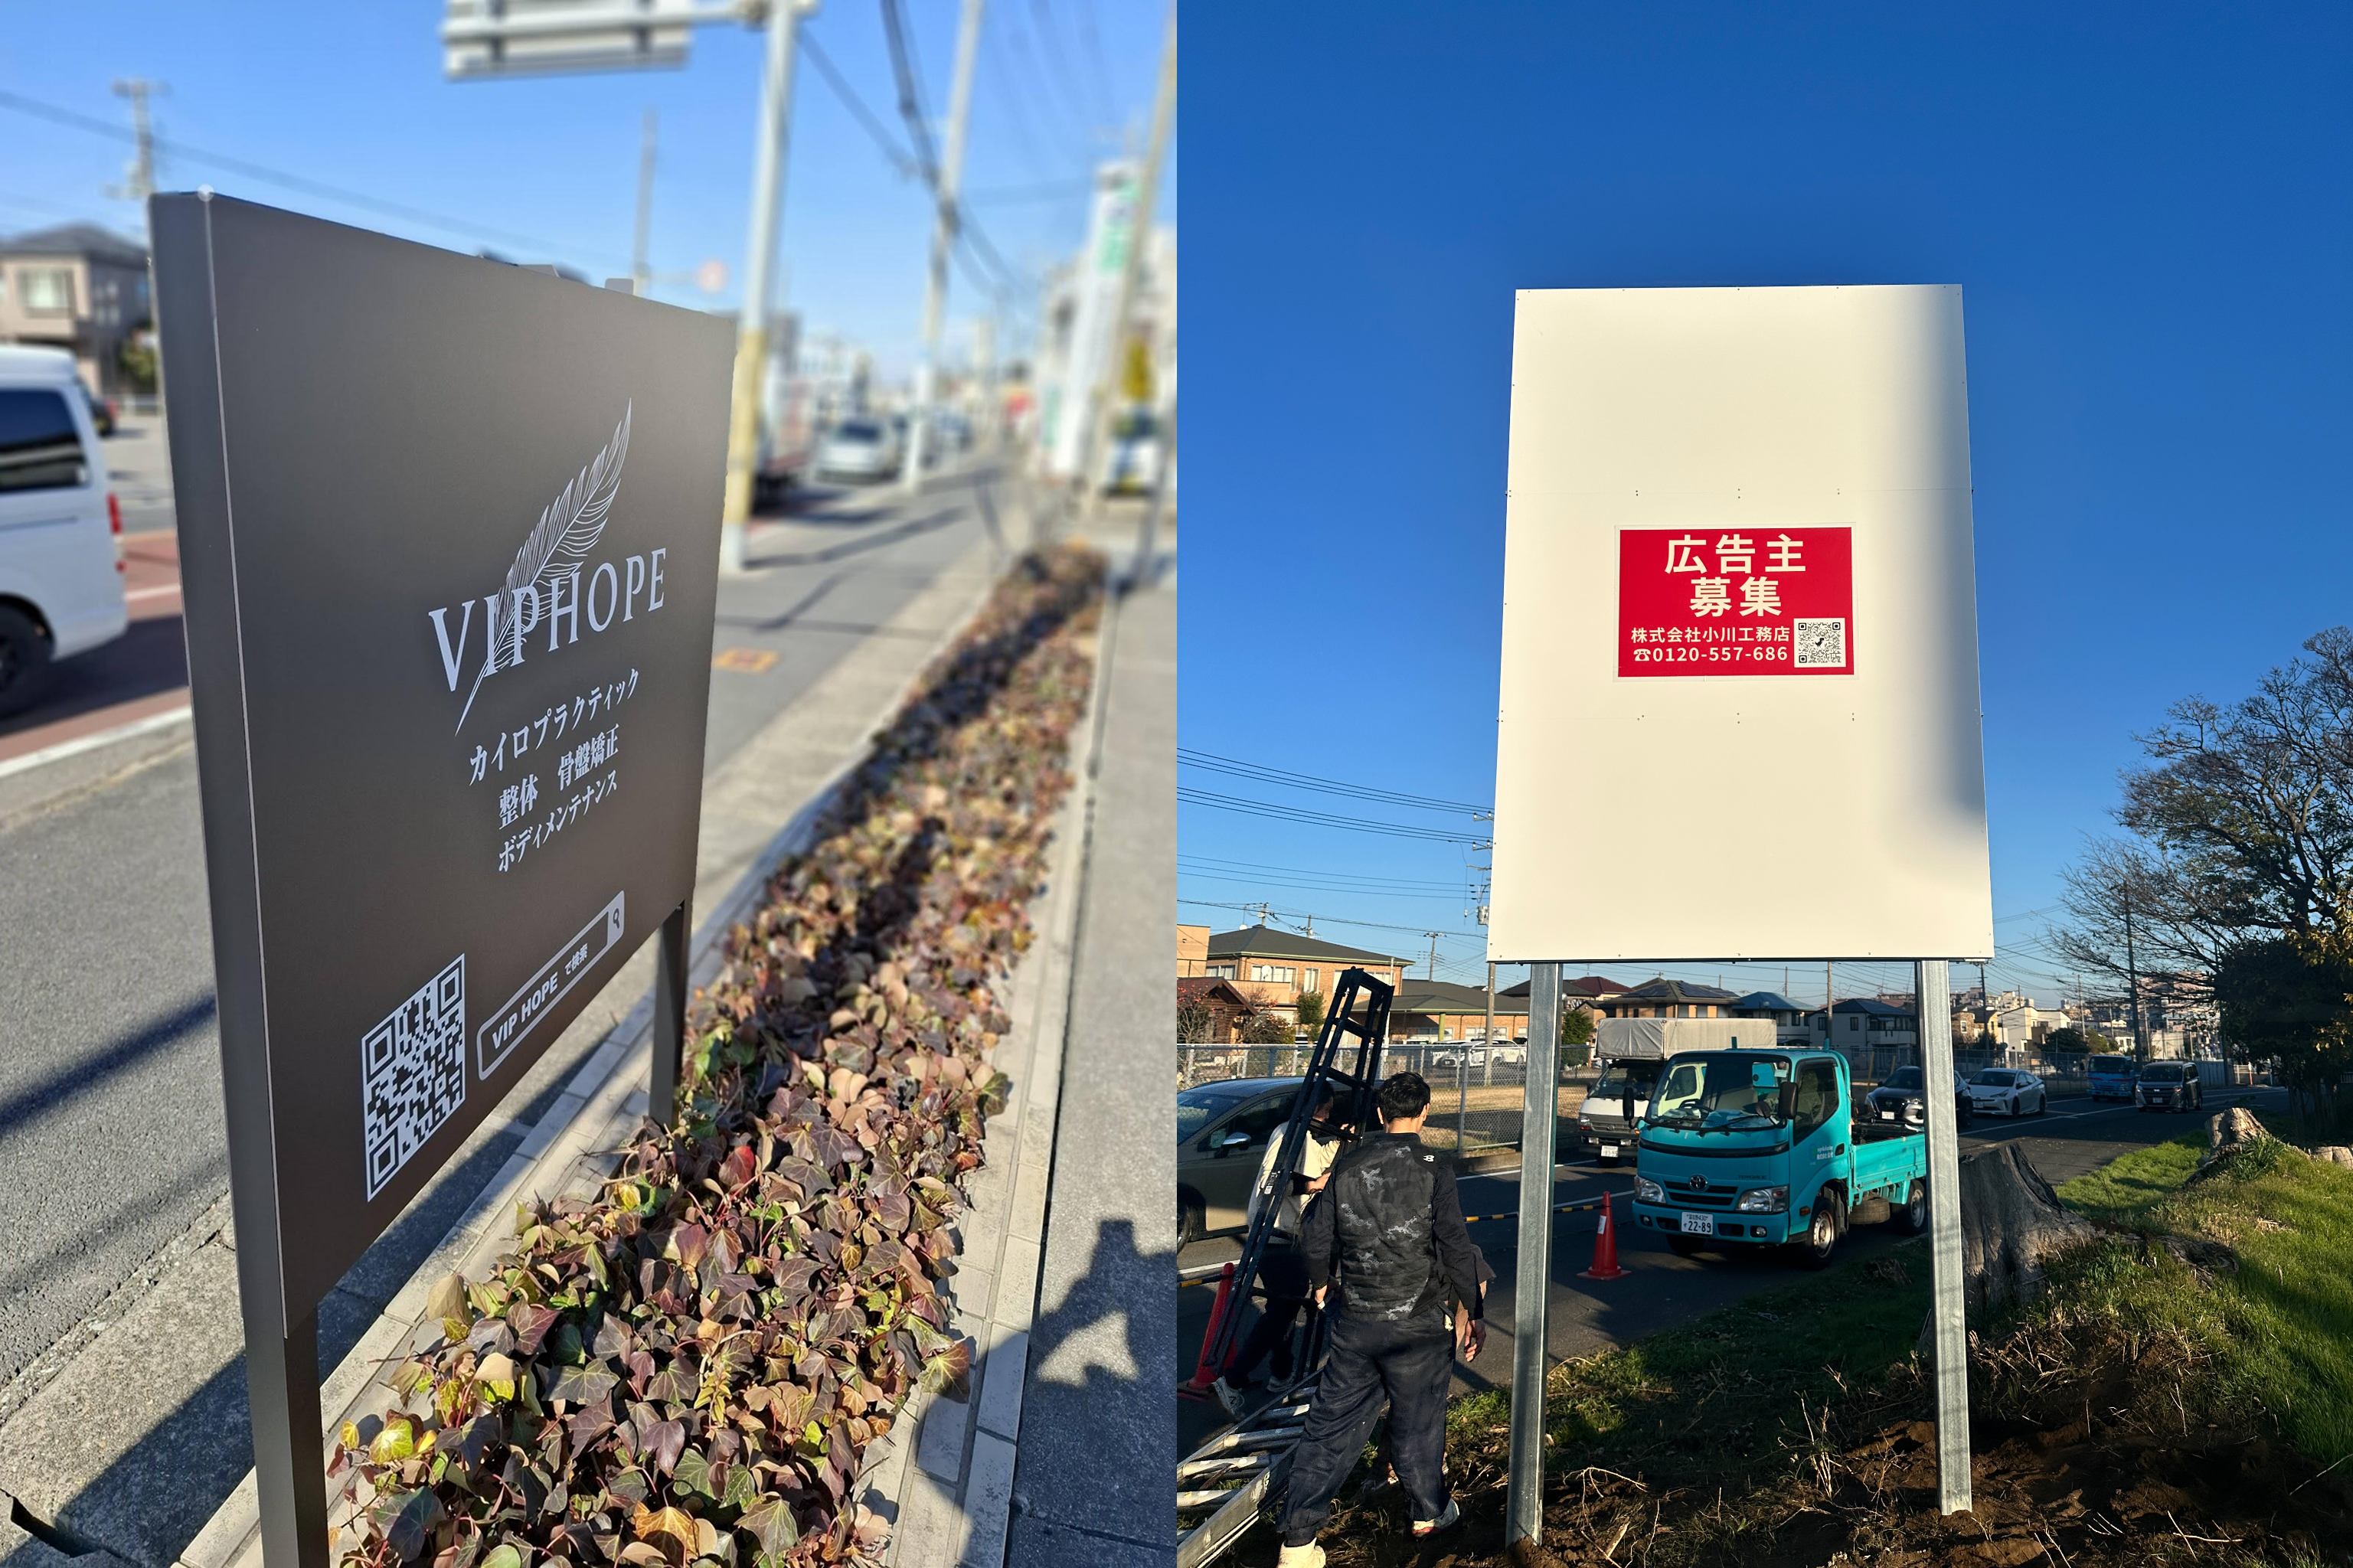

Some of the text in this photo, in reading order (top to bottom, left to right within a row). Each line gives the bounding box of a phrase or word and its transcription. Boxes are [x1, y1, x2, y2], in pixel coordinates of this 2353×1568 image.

[1665, 533, 1806, 573] 広告主
[1689, 577, 1782, 617] 募集
[1631, 626, 1790, 643] 株式会社小川工務店
[469, 668, 639, 786] カイロプラクティック
[499, 724, 619, 830] 整体 骨盤矯正
[498, 769, 617, 872] ボディメンテナンス
[492, 943, 588, 1050] VIP HOPE で検索
[1688, 1220, 1711, 1233] 22-89
